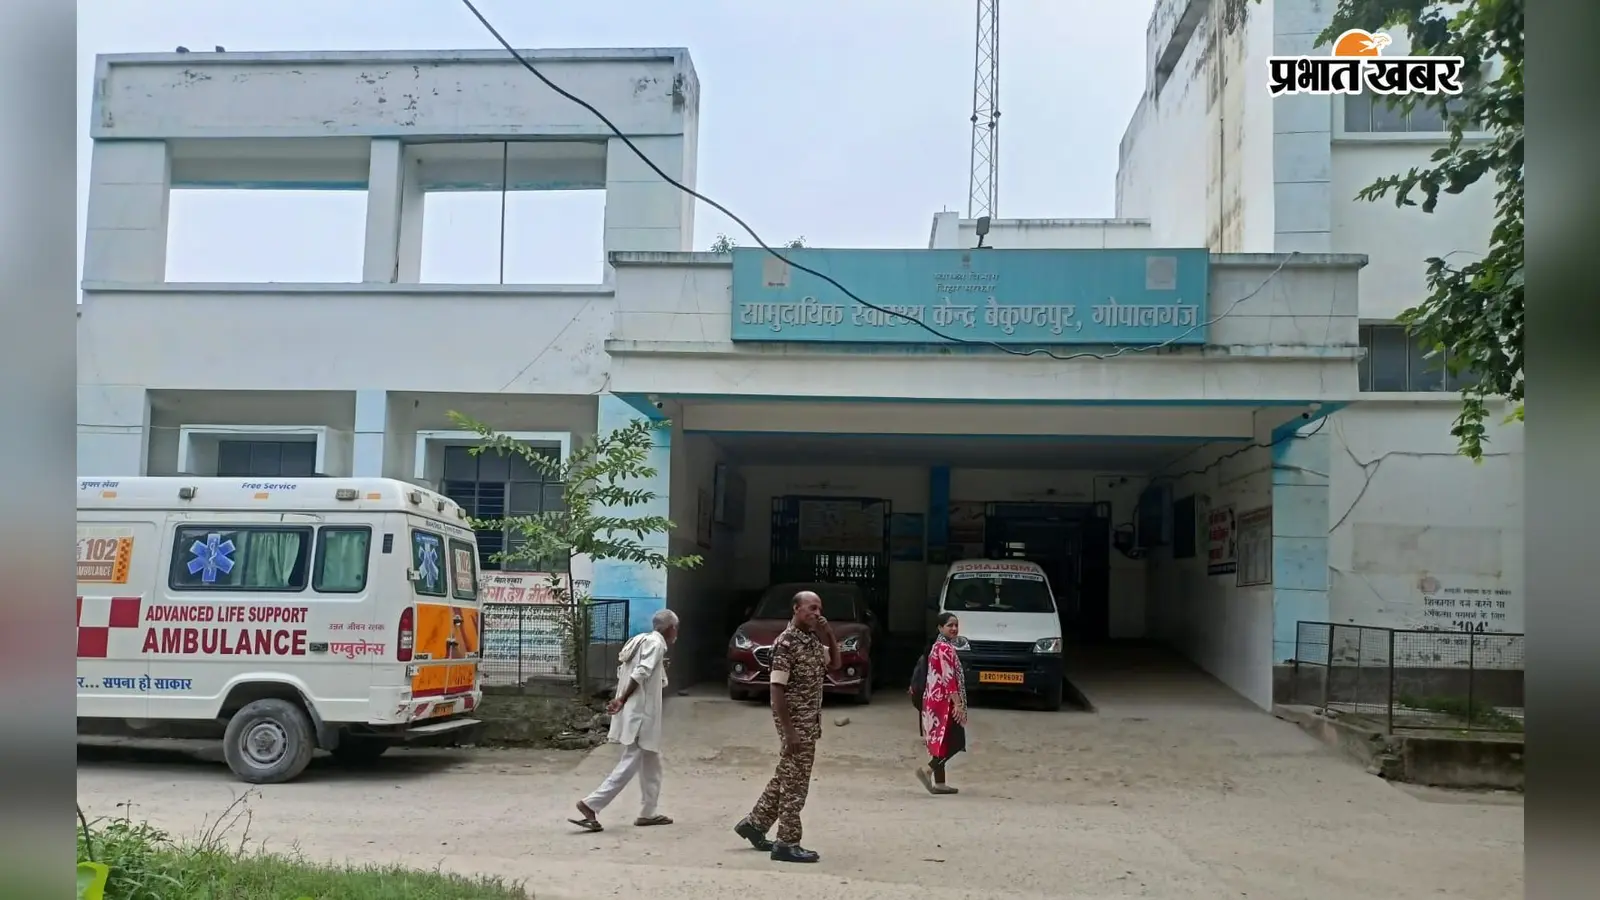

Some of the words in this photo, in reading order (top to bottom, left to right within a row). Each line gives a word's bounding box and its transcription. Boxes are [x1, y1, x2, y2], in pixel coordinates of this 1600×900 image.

[739, 296, 845, 332] सामुदायिक
[851, 302, 927, 328] स्वास्थ्य
[932, 296, 978, 329] केन्द्र
[1091, 296, 1200, 328] गोपालगंज
[263, 481, 297, 490] Service
[86, 538, 118, 561] 102
[145, 605, 214, 622] ADVANCED
[217, 606, 245, 622] LIFE
[248, 607, 308, 623] SUPPORT
[346, 621, 366, 631] जीवन
[142, 627, 307, 656] AMBULANCE
[329, 637, 386, 660] एम्बुलेन्स
[102, 676, 135, 689] सपना
[138, 674, 151, 692] हो
[154, 678, 193, 690] साकार
